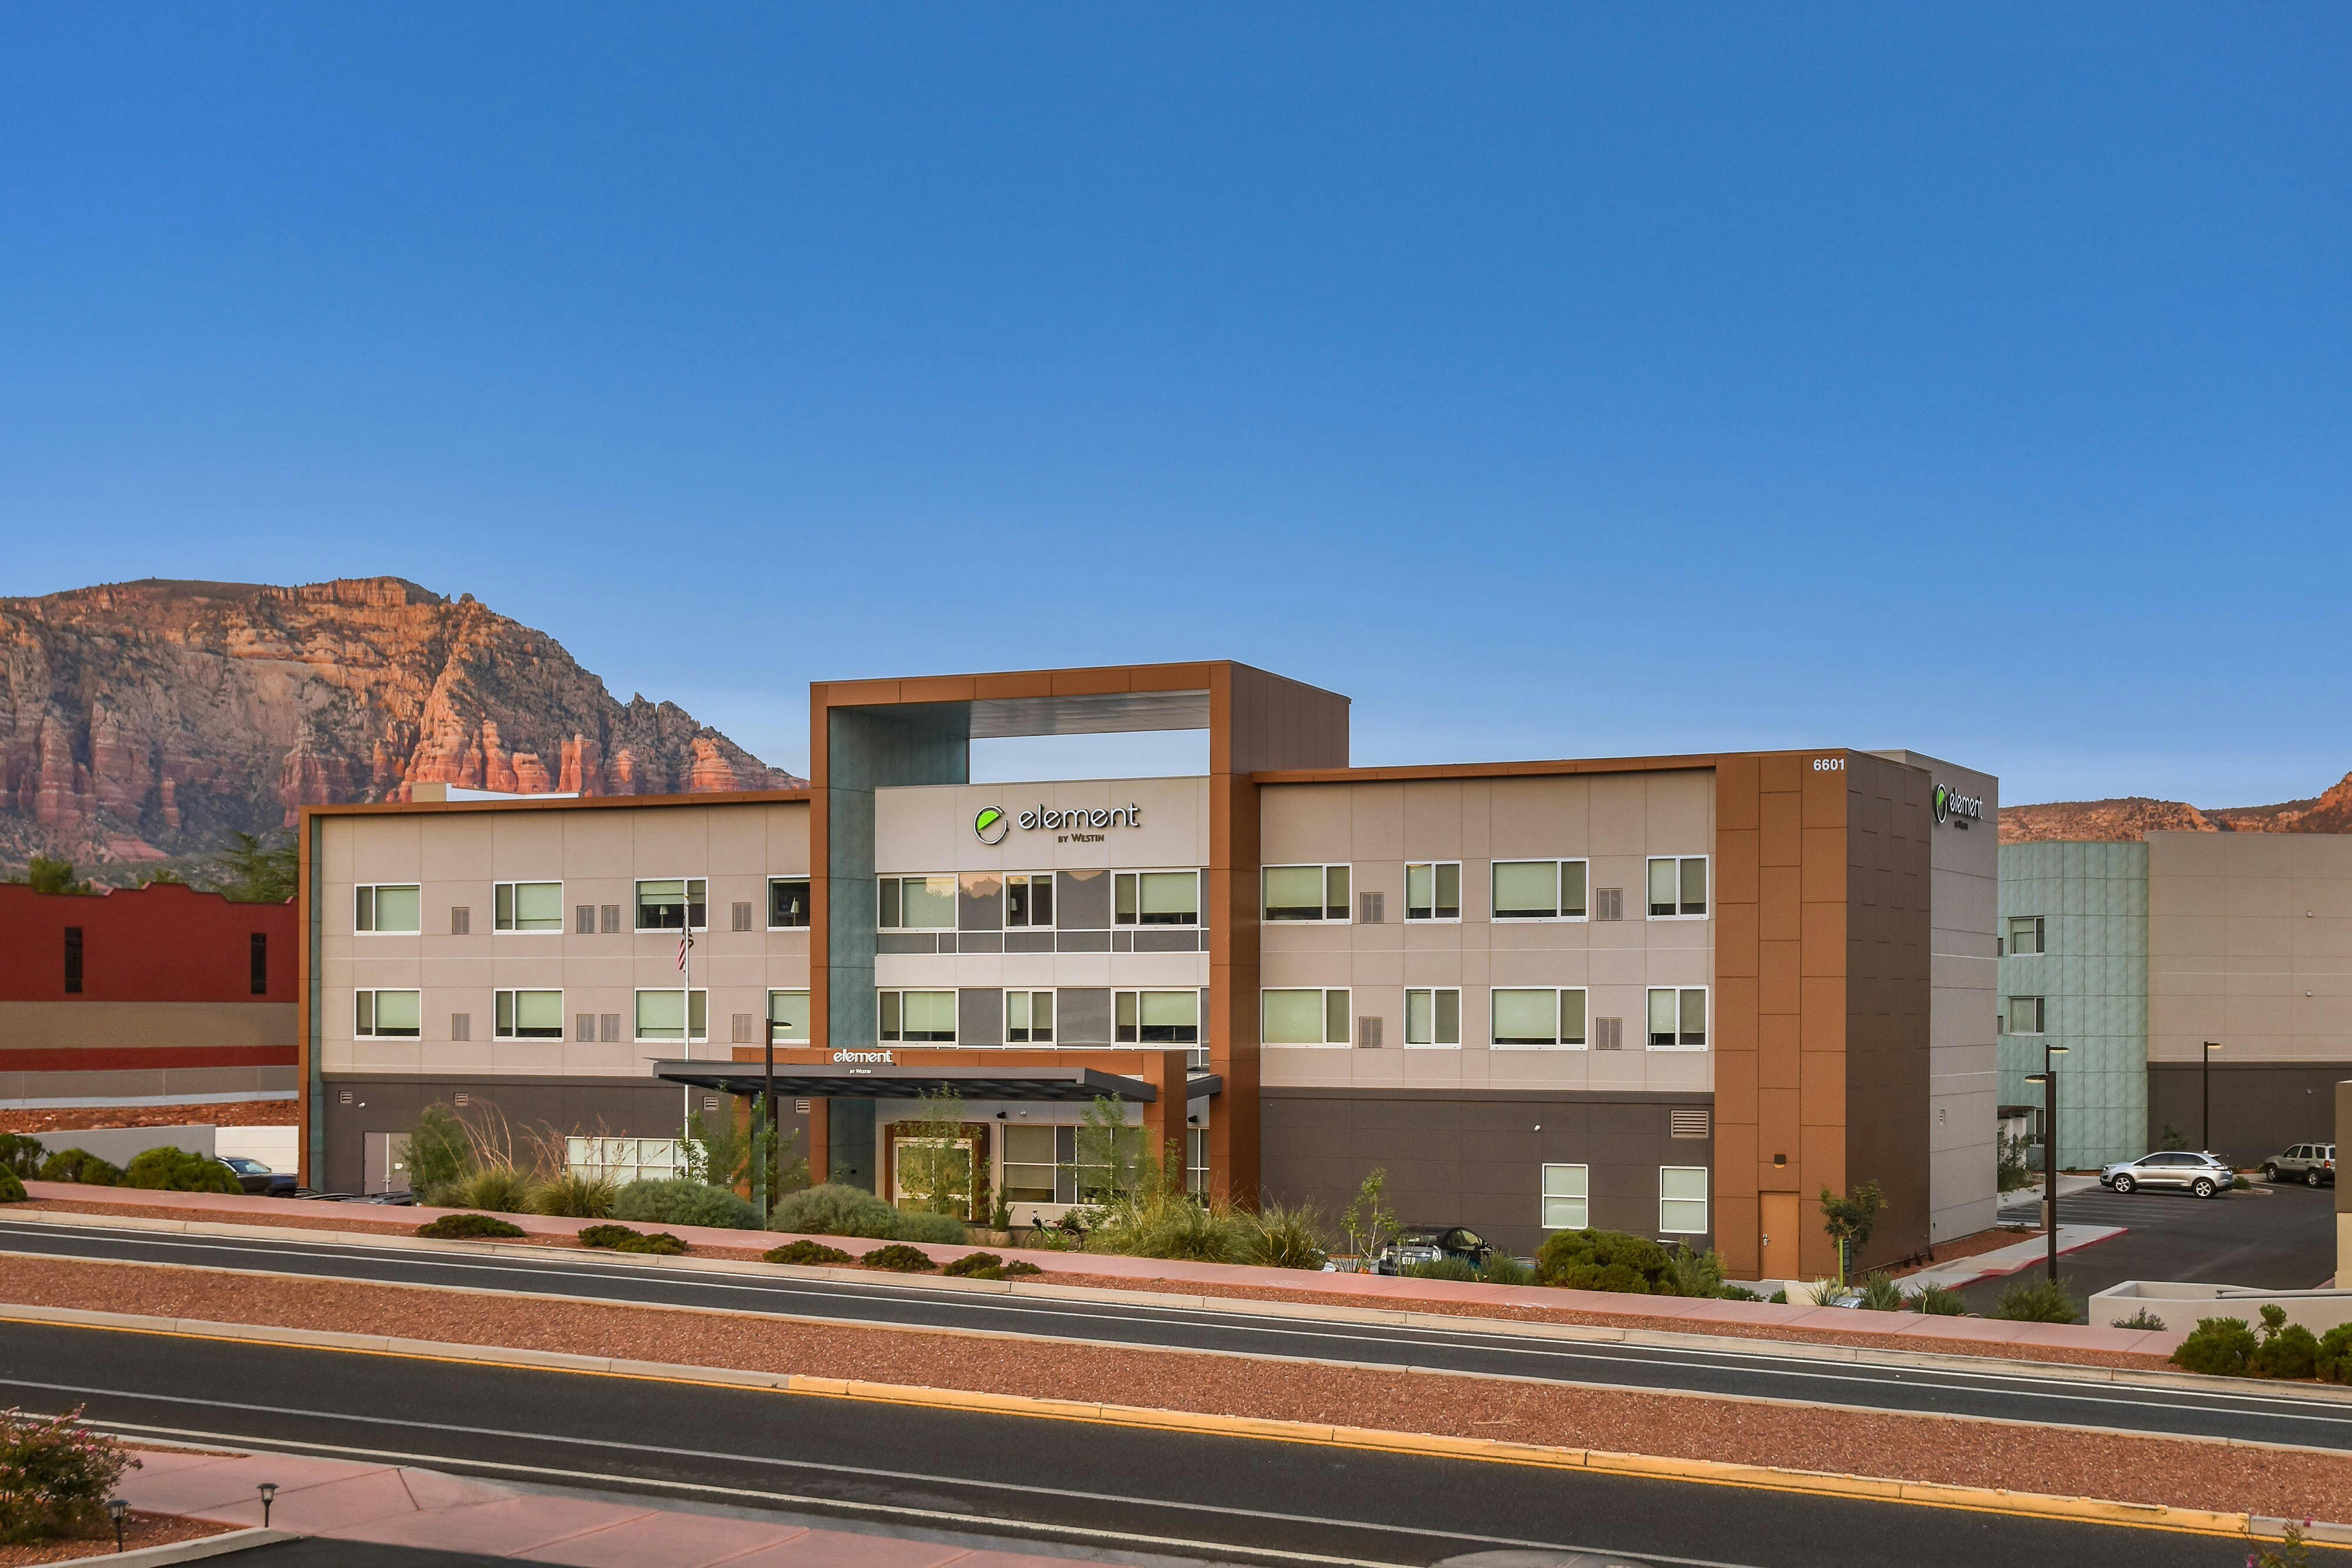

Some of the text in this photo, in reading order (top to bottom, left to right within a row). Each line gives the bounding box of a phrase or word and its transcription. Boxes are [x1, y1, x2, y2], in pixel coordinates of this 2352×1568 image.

[1813, 758, 1845, 771] 6601
[1949, 787, 1983, 819] element
[1018, 802, 1140, 830] element
[833, 1048, 893, 1063] element
